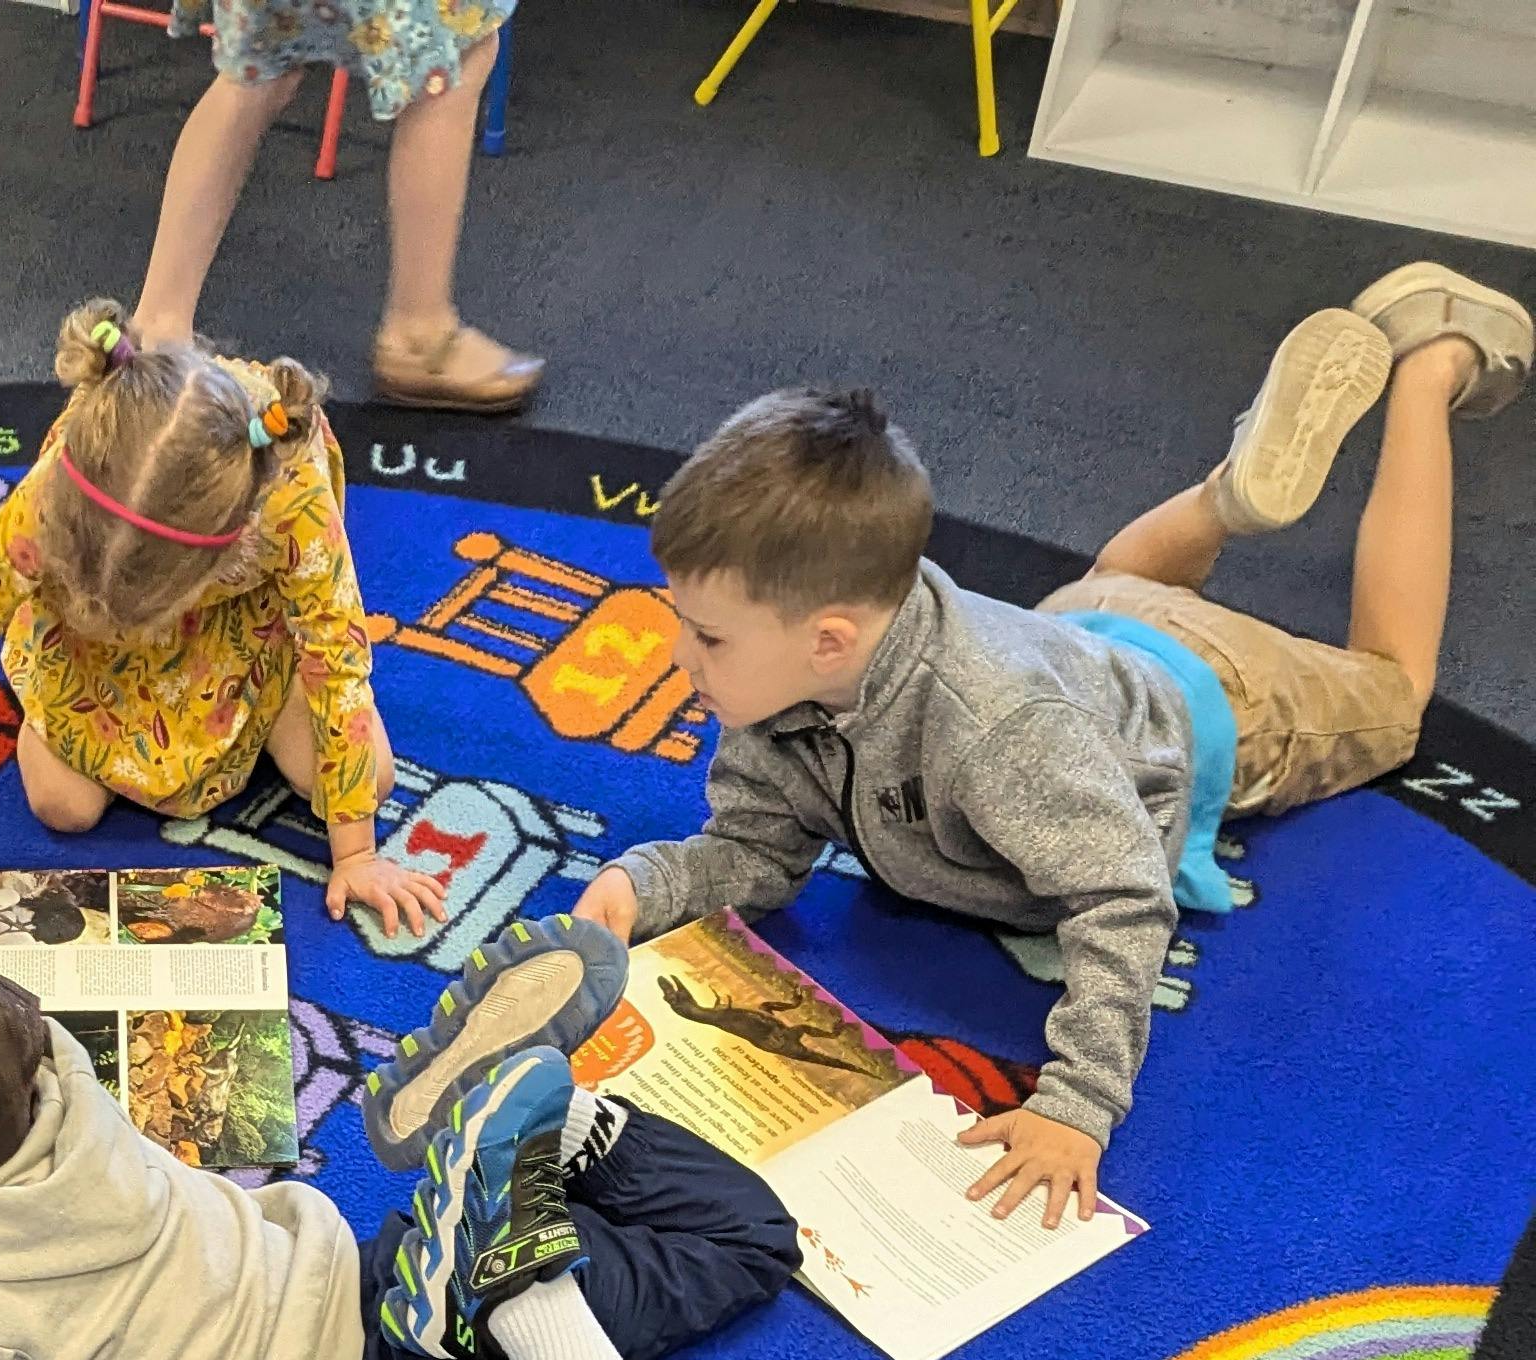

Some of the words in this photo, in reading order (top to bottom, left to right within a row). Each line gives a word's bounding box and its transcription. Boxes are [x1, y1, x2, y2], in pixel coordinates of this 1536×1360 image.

[370, 443, 466, 482] Uu
[552, 623, 664, 706] 12
[1404, 762, 1522, 822] Zz
[678, 1035, 706, 1060] there
[730, 1042, 745, 1056] of
[658, 1057, 682, 1078] time
[662, 1041, 706, 1080] scientists
[702, 1056, 724, 1076] that
[727, 1059, 752, 1081] least
[742, 1052, 781, 1086] species
[626, 1068, 663, 1101] million
[651, 1070, 670, 1088] did
[679, 1074, 706, 1099] same
[702, 1076, 721, 1093] but
[667, 1084, 707, 1119] Humans
[703, 1095, 720, 1111] the
[719, 1072, 771, 1114] discovered
[775, 1081, 822, 1117] different
[728, 1116, 748, 1134] live
[766, 1108, 794, 1132] have
[563, 1099, 616, 1181] NIK
[745, 1129, 764, 1146] not
